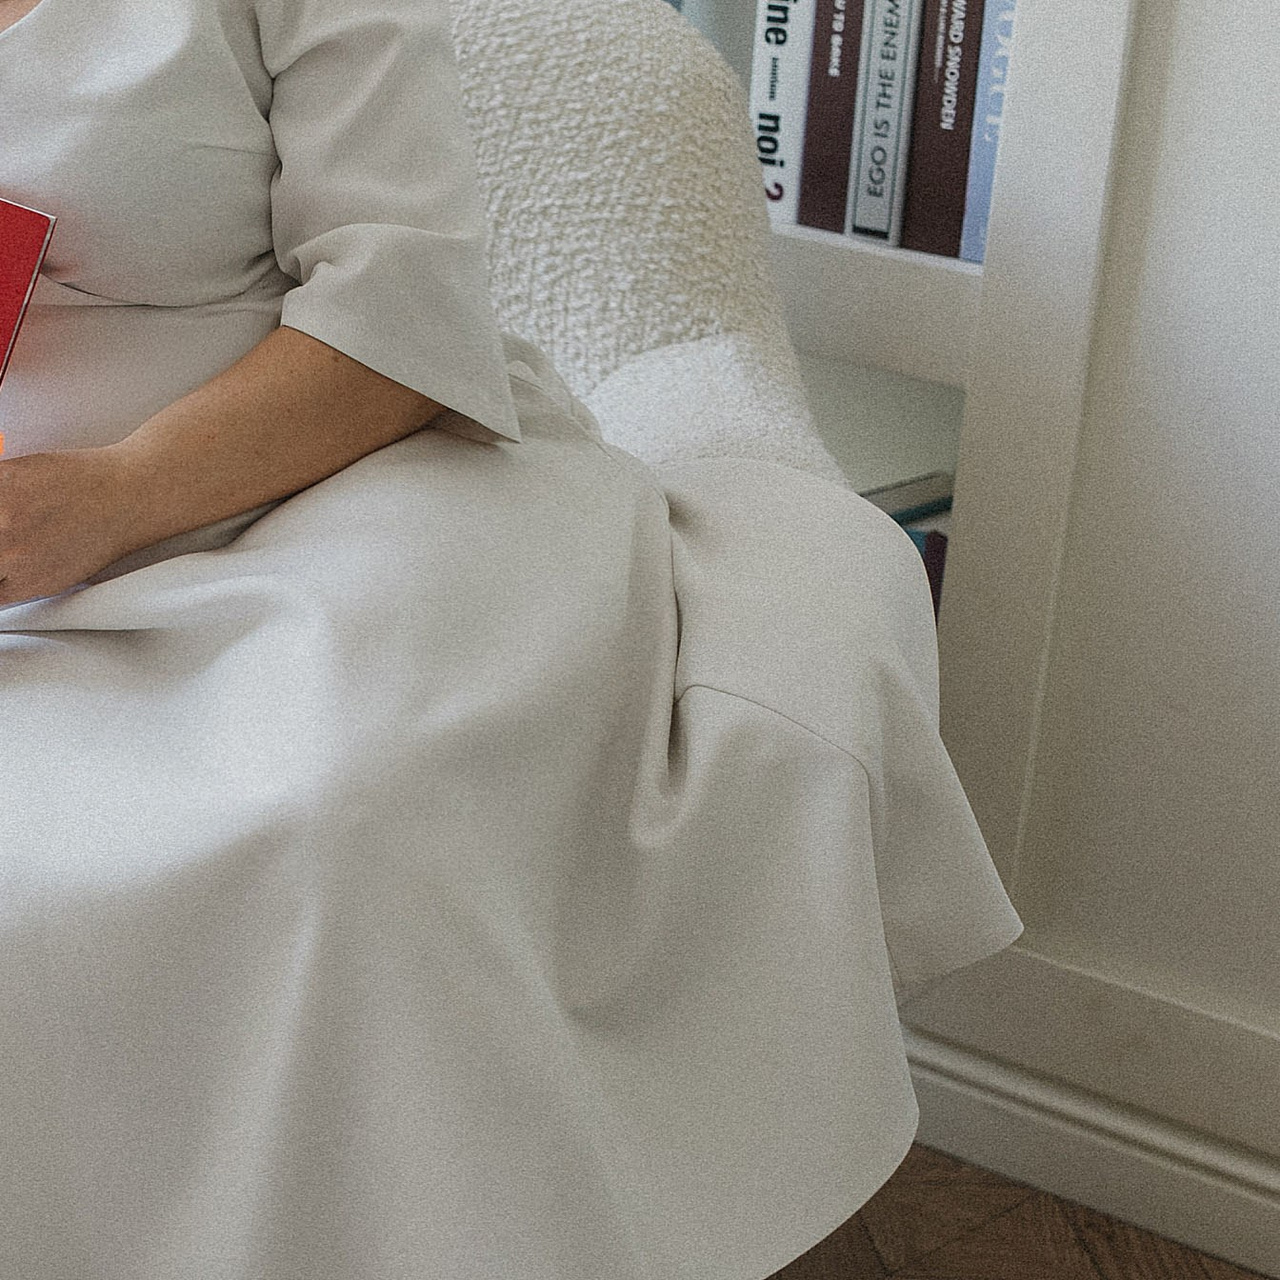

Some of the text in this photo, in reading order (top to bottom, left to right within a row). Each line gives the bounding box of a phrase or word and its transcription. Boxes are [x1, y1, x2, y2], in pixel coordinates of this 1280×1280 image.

[876, 70, 895, 109] THE
[940, 45, 962, 131] SNOWDEN
[757, 112, 784, 167] noi
[874, 120, 890, 138] IS
[868, 145, 888, 198] EGO
